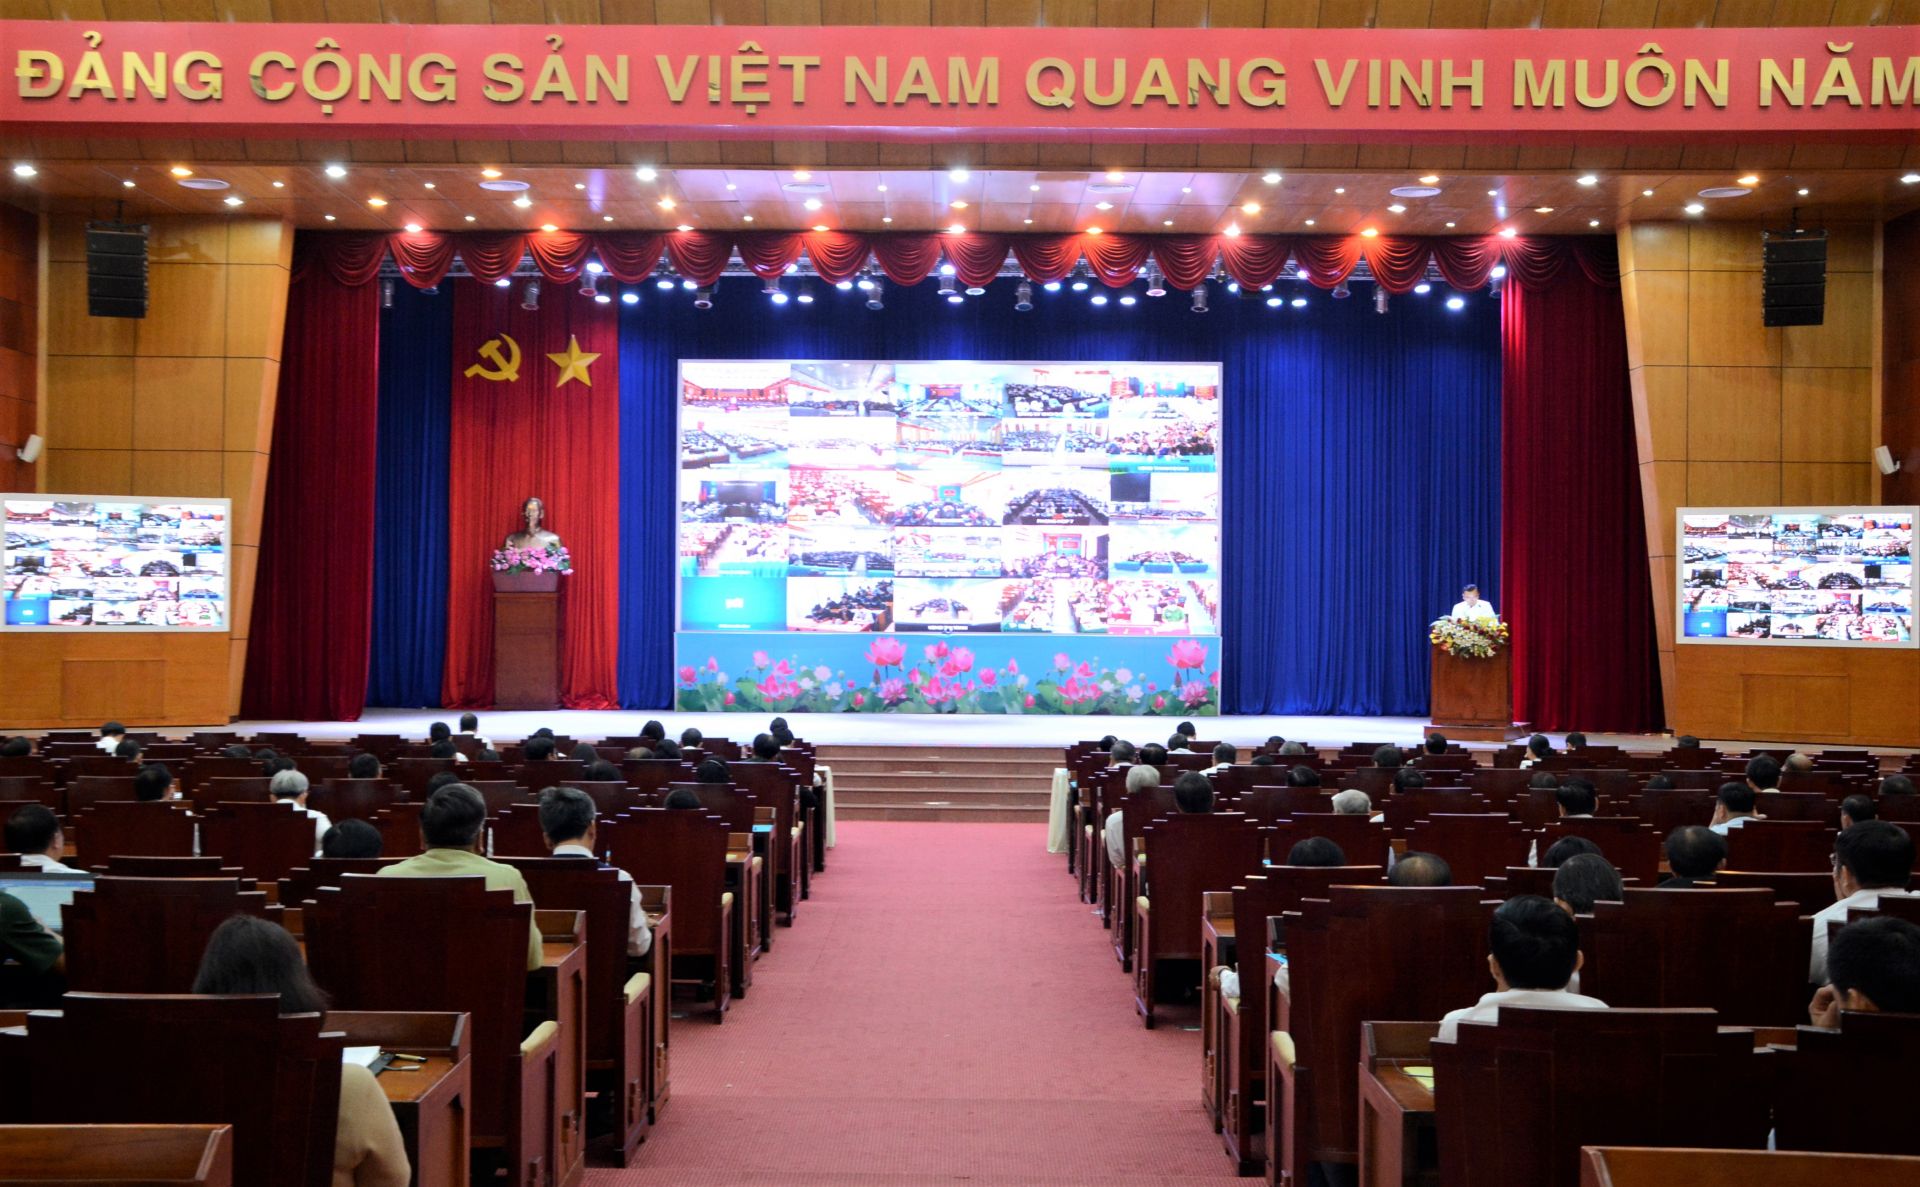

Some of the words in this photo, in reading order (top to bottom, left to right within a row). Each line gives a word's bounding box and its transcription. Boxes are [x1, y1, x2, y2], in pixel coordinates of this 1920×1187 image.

[15, 31, 224, 100] ĐẢNG
[249, 37, 457, 114] CỘNG
[483, 34, 629, 102] SẢN
[656, 41, 821, 114] VIỆT
[845, 56, 999, 104] NAM
[1026, 58, 1287, 108] QUANG
[1315, 58, 1485, 107] VINH
[1512, 42, 1729, 108] MUÔN
[1759, 41, 1920, 107] NĂM
